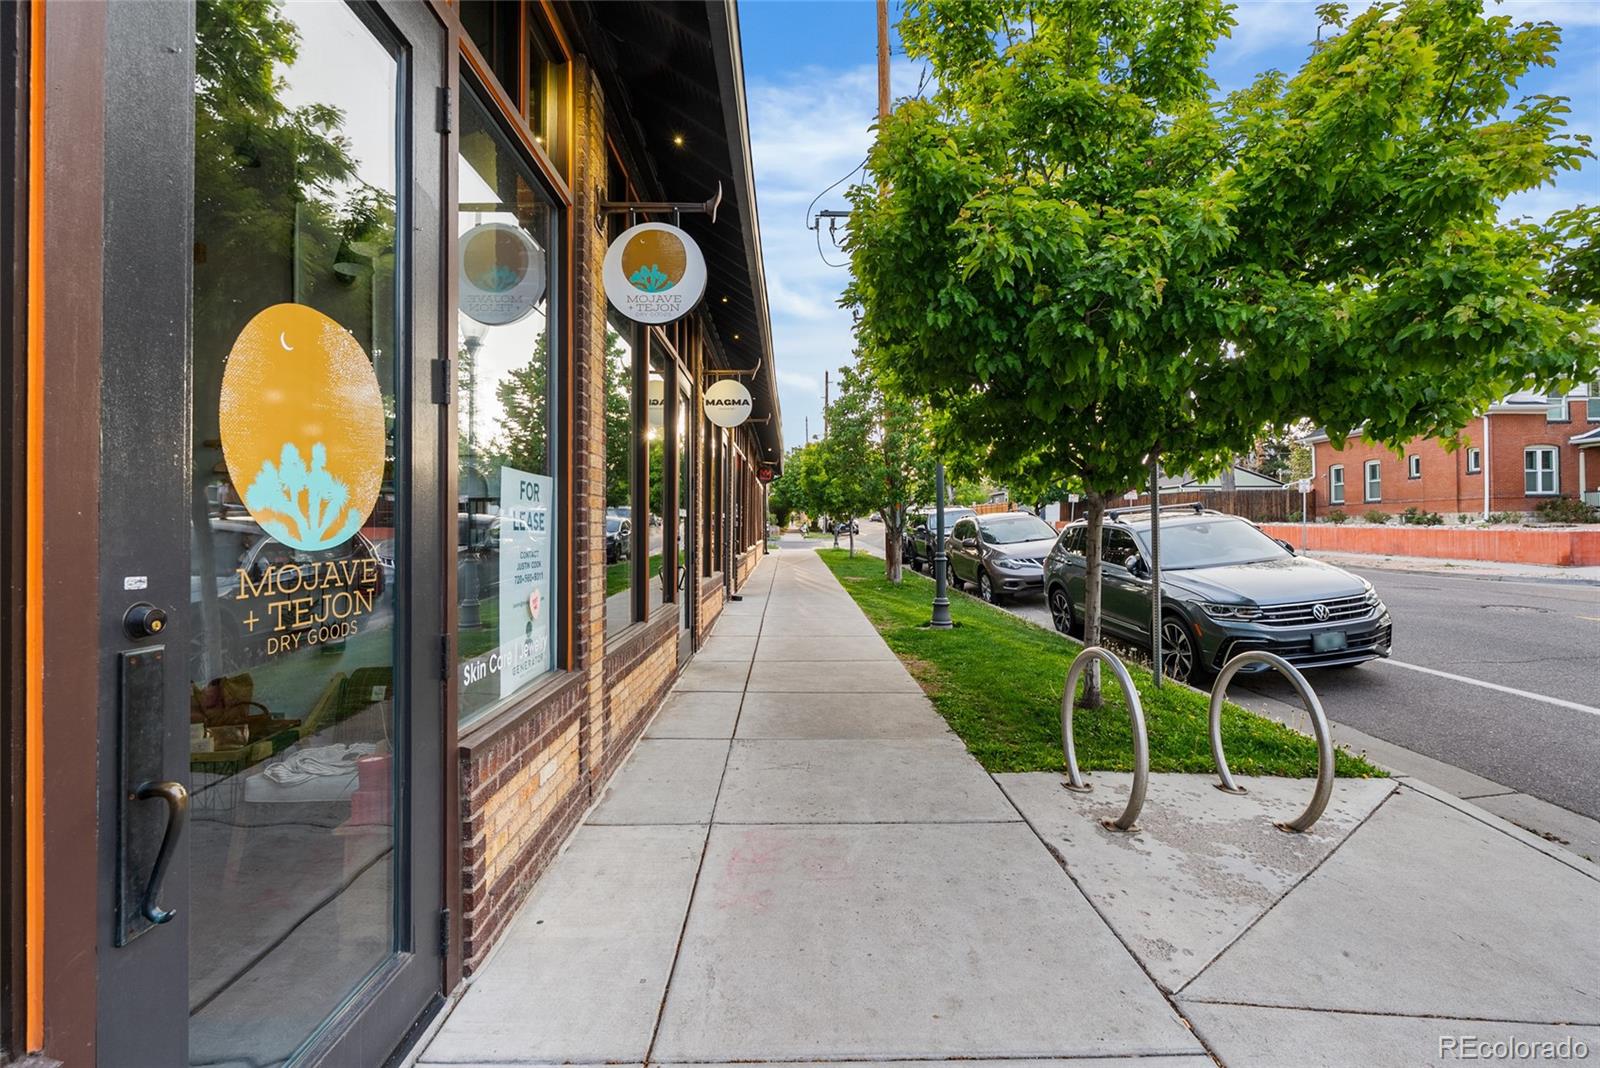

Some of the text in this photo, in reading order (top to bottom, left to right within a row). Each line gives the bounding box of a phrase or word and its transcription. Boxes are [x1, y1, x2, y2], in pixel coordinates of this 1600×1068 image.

[626, 294, 682, 303] MOJAVE
[636, 303, 680, 312] TEJON
[705, 398, 750, 406] MAGMA
[519, 480, 540, 502] FOR
[512, 511, 545, 531] LEASE
[236, 559, 378, 600] MOJAVE
[268, 588, 376, 632] TEJON
[267, 620, 358, 655] DRY GOODS
[463, 660, 487, 686] Skin
[489, 650, 513, 674] Care
